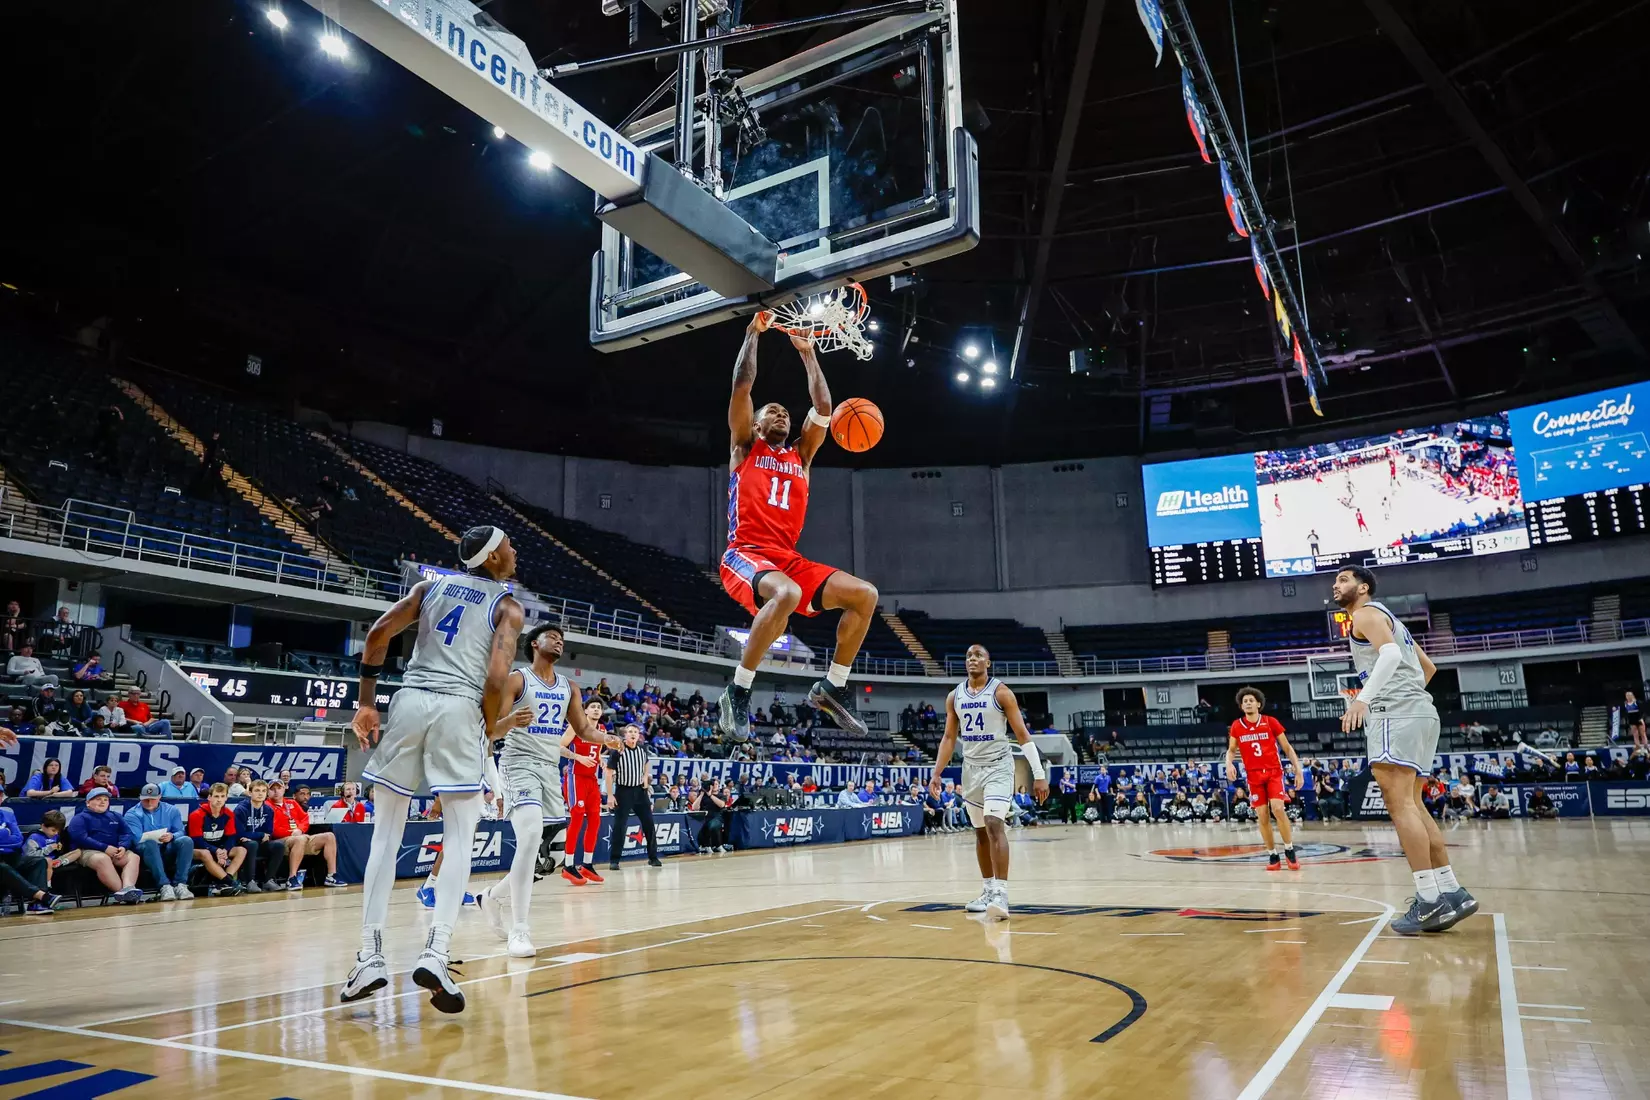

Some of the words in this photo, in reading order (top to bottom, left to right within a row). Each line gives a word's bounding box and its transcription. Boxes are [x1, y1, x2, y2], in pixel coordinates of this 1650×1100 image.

[246, 360, 261, 376] 309
[1533, 394, 1634, 434] Connected
[755, 455, 793, 475] LOUISIANA
[767, 476, 792, 511] 11
[1185, 485, 1248, 507] Health
[601, 499, 610, 508] 311
[1477, 538, 1498, 551] 53
[1372, 545, 1410, 561] 10:13
[1291, 559, 1313, 573] 45
[1523, 559, 1536, 571] 316
[442, 583, 487, 606] BUFFORD
[435, 604, 467, 648] 4
[1501, 670, 1516, 683] 213
[221, 679, 248, 697] 45
[535, 691, 565, 701] MIDDLE
[271, 694, 284, 704] TOL
[292, 696, 298, 705] 3
[961, 701, 987, 710] MIDDLE
[1158, 692, 1169, 703] 211
[538, 703, 562, 725] 22
[963, 712, 985, 732] 24
[528, 726, 564, 737] TENNESS
[588, 746, 598, 760] 5
[1251, 742, 1263, 757] 3
[746, 763, 784, 785] USA
[811, 767, 832, 787] NO
[837, 768, 887, 788] LIMITS
[890, 770, 912, 786] ON
[1474, 761, 1504, 777] DEFENSE
[1361, 797, 1387, 810] US
[1607, 788, 1650, 809] ES
